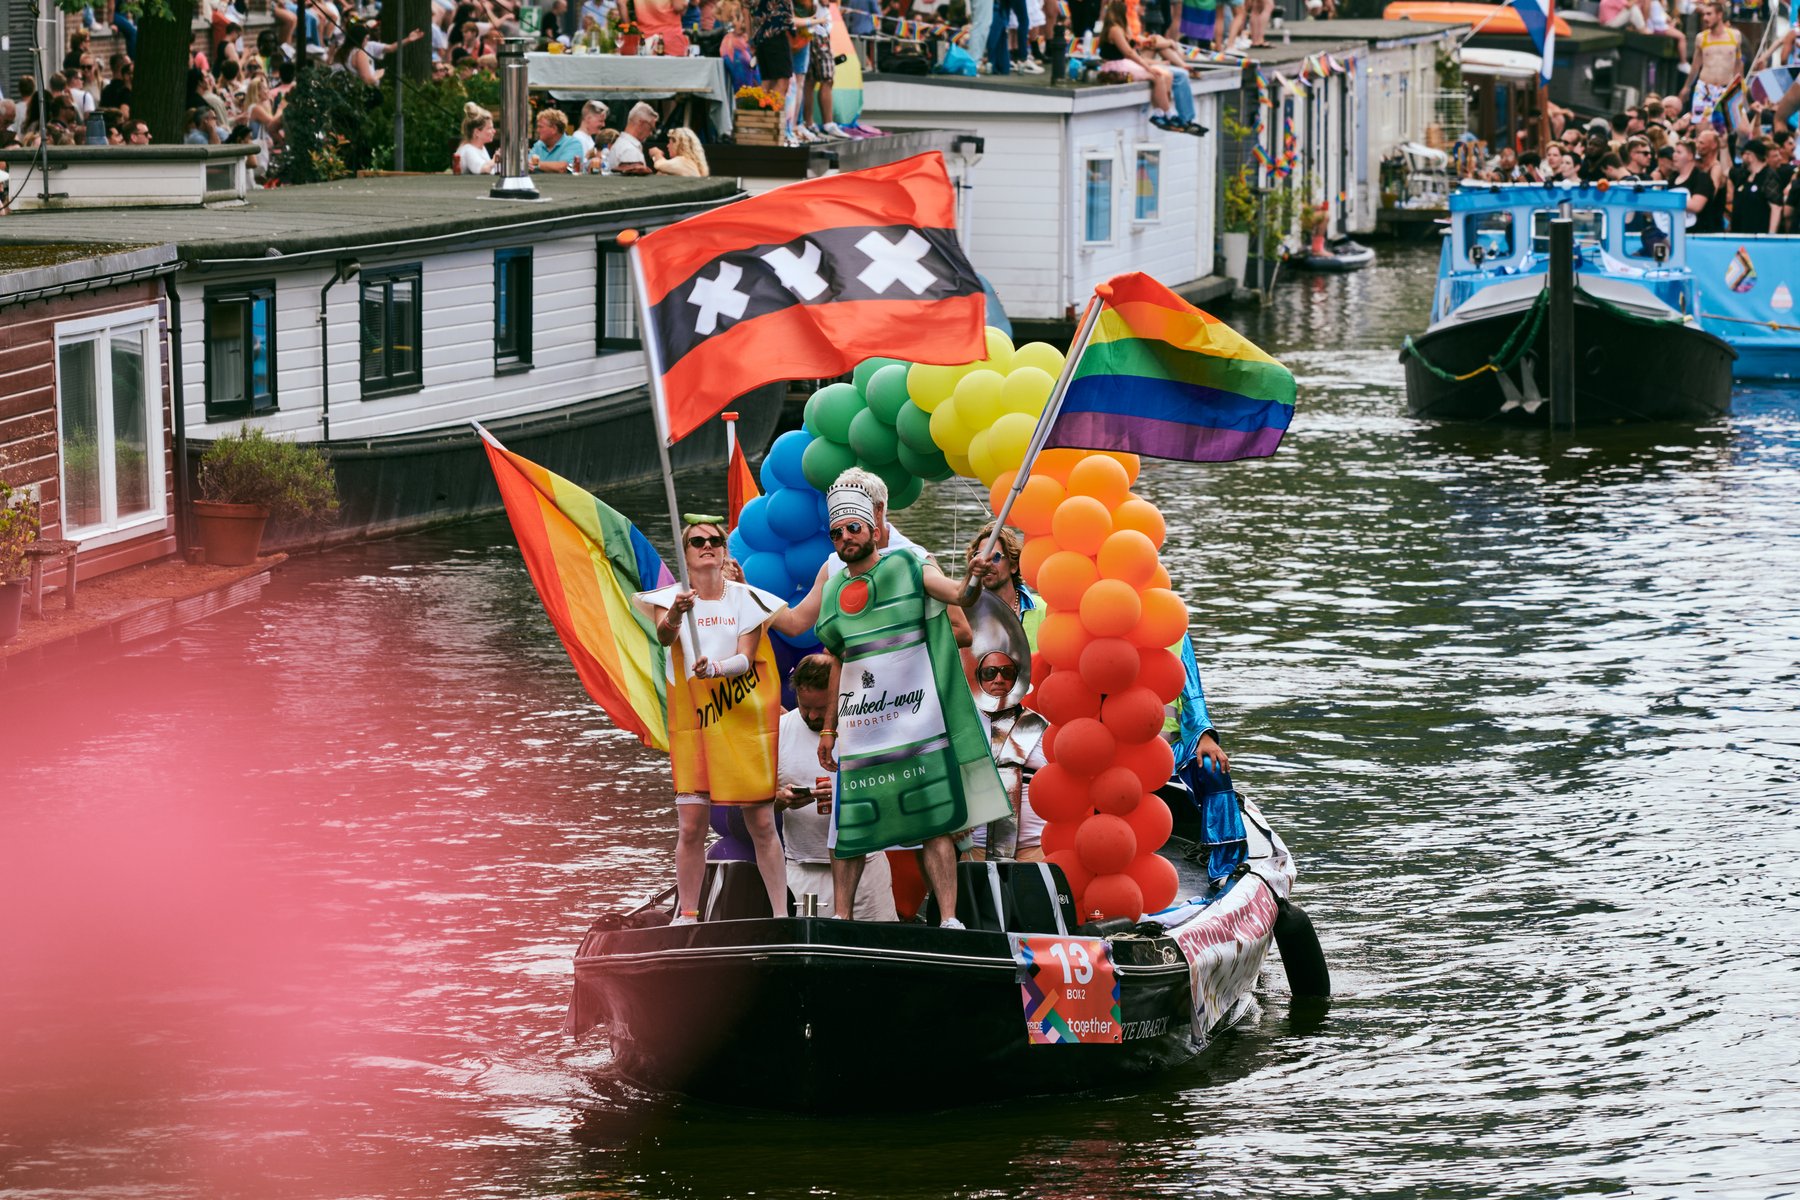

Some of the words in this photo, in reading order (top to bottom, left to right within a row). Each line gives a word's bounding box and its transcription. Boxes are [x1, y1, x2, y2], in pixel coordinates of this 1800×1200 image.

[697, 616, 736, 627] REMIUM
[838, 688, 925, 717] Thanked-way
[846, 711, 900, 728] IMPORTED
[843, 773, 896, 791] LONDON
[903, 765, 926, 779] GIN
[1050, 942, 1094, 985] 13
[1027, 1021, 1044, 1030] PRIDE
[1066, 1016, 1113, 1037] together
